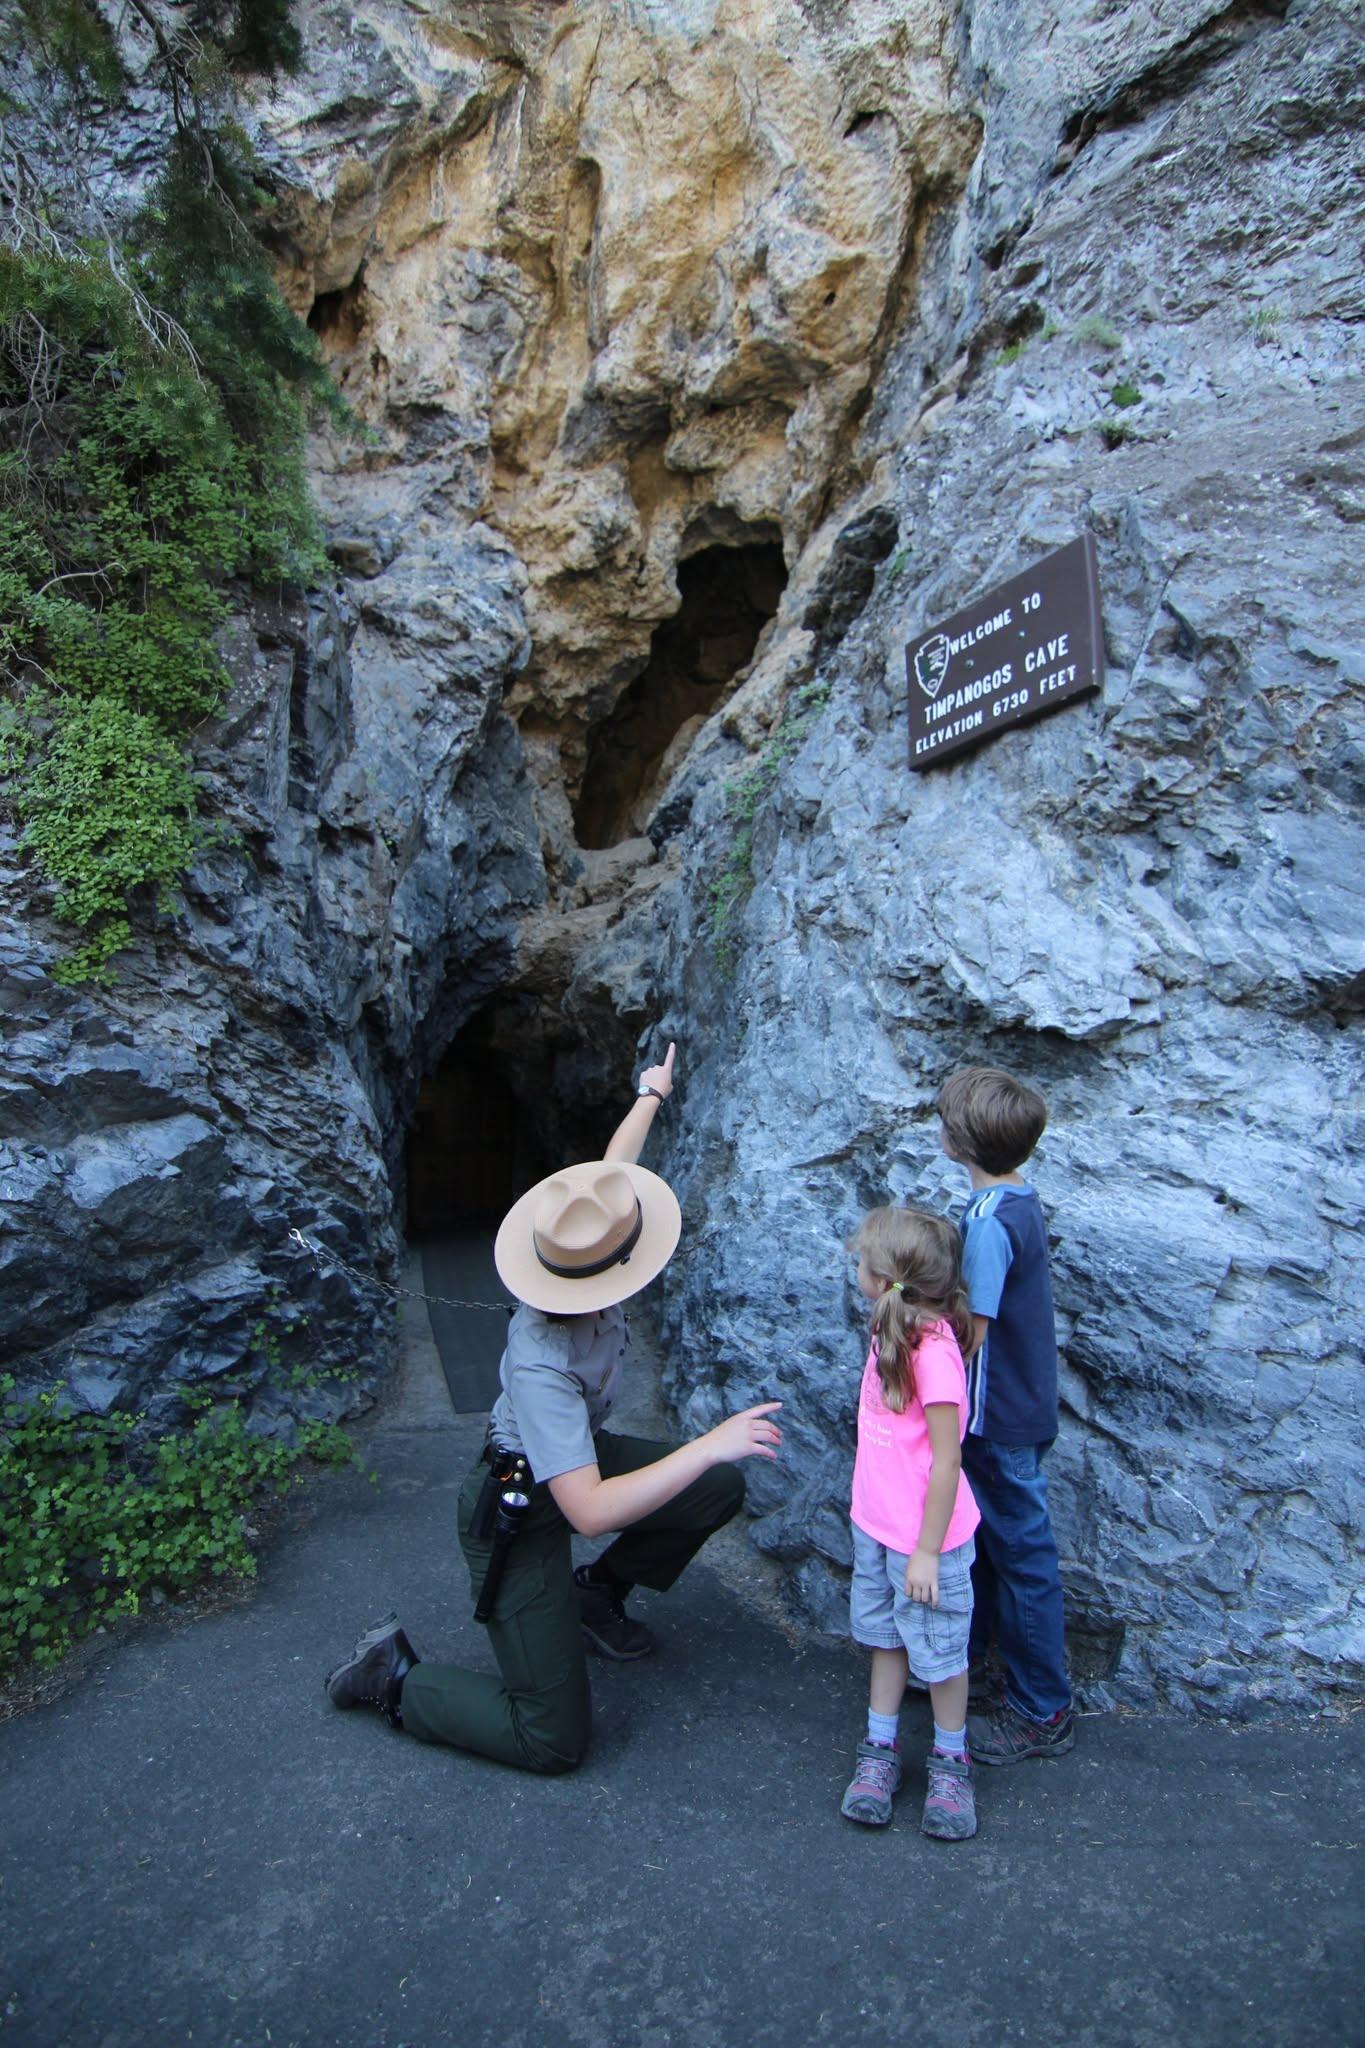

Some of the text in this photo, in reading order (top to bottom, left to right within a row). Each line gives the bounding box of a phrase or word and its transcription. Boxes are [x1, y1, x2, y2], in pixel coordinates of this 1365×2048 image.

[950, 608, 1012, 656] WELCOME
[1022, 592, 1041, 613] TO
[915, 664, 1076, 754] ELEVATION 6730 FEET
[924, 634, 1069, 724] TIMPANOGOS CAVE
